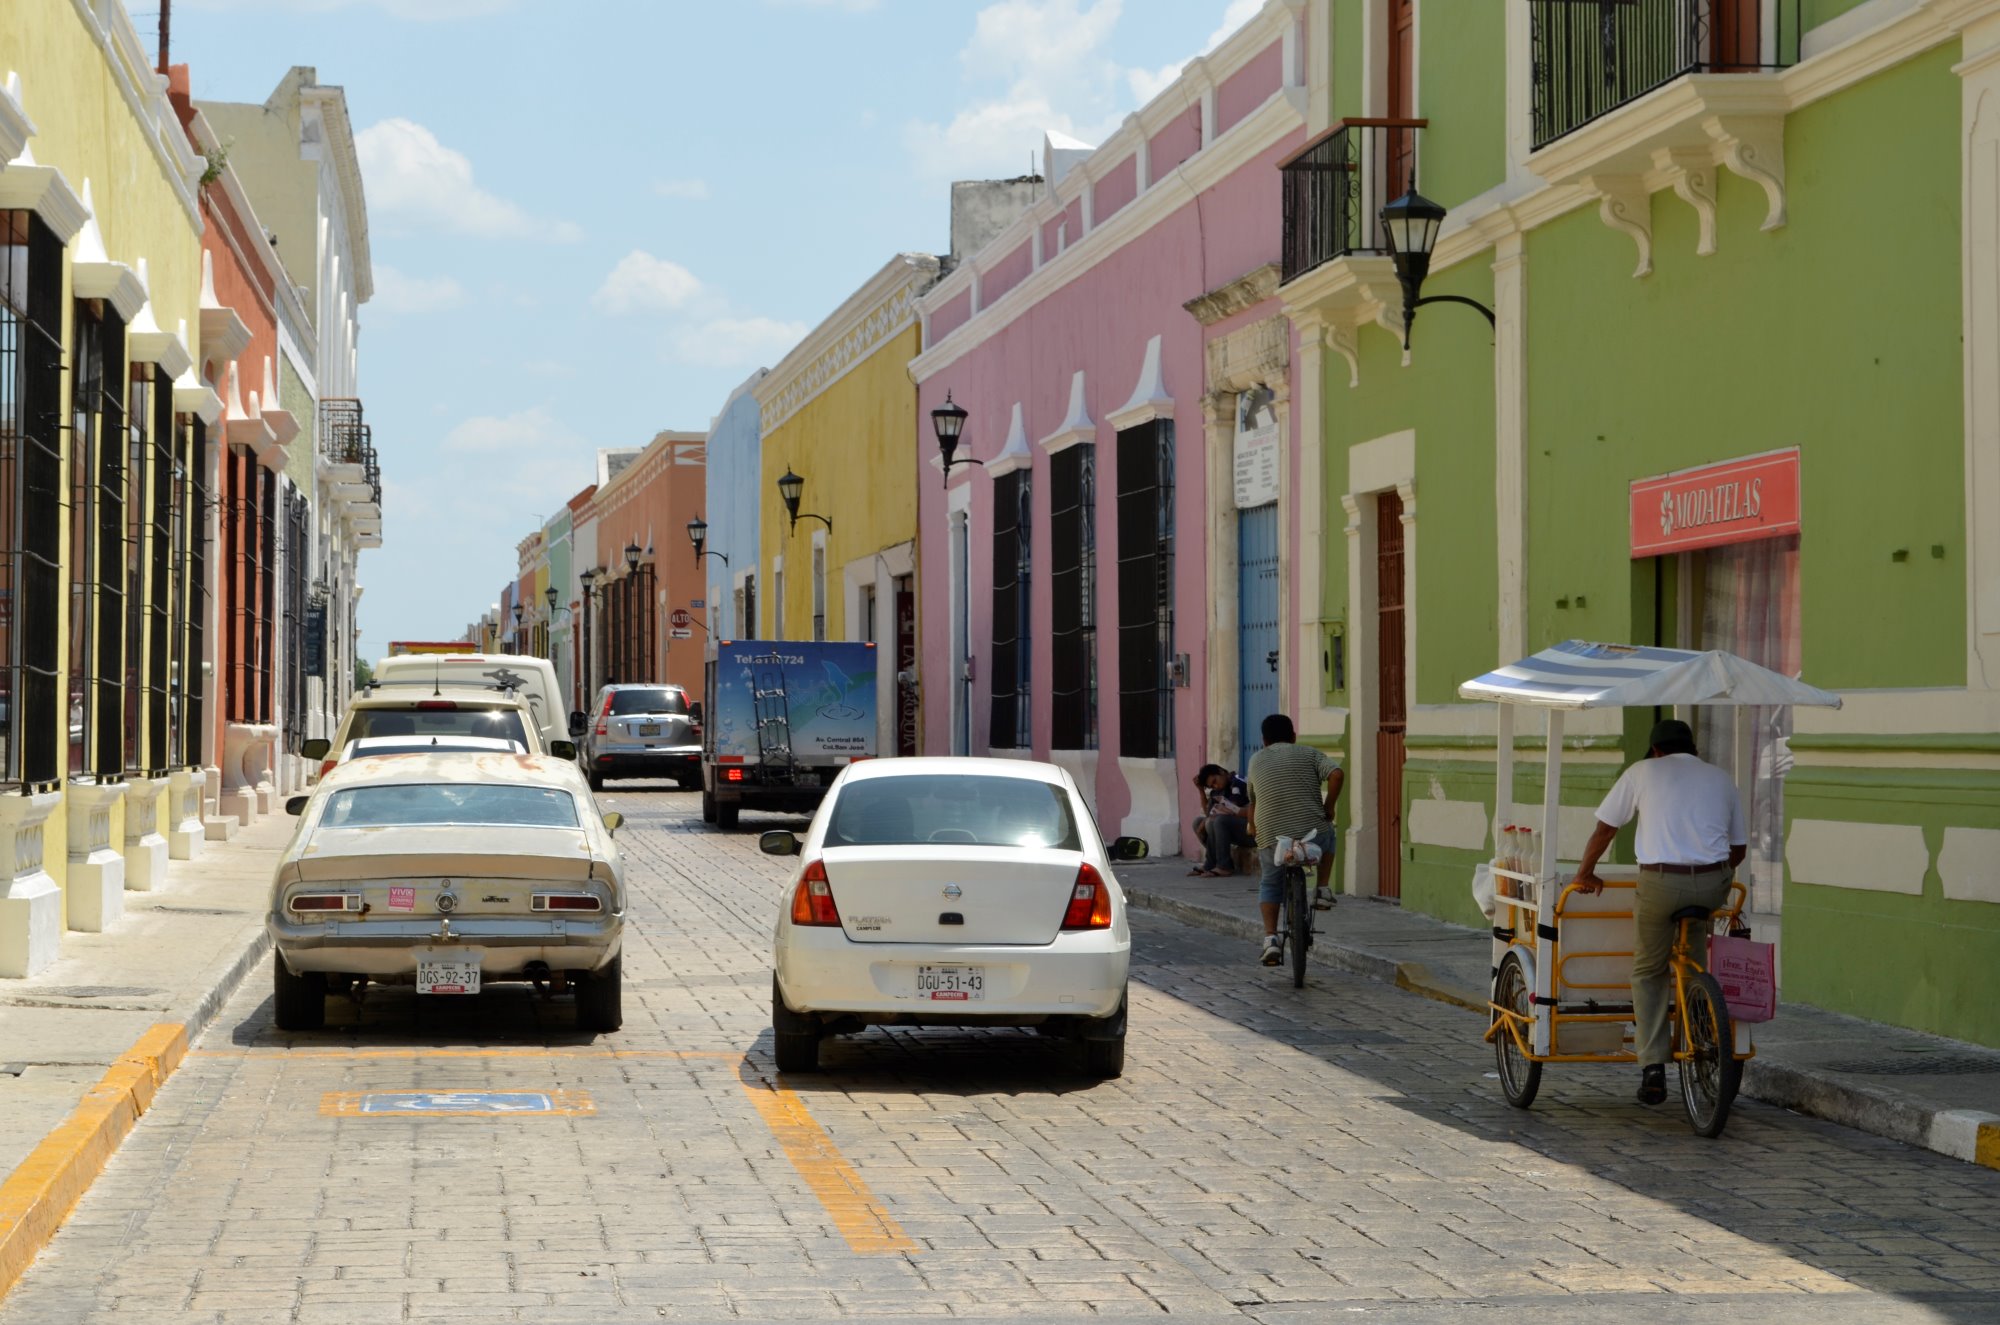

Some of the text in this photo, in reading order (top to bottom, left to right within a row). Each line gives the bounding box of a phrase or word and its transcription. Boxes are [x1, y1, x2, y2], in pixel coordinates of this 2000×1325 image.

[1673, 478, 1762, 531] MODATELAS
[671, 614, 690, 623] ALTO
[419, 970, 478, 984] DGS-92-37
[917, 975, 983, 990] DGU-51-43
